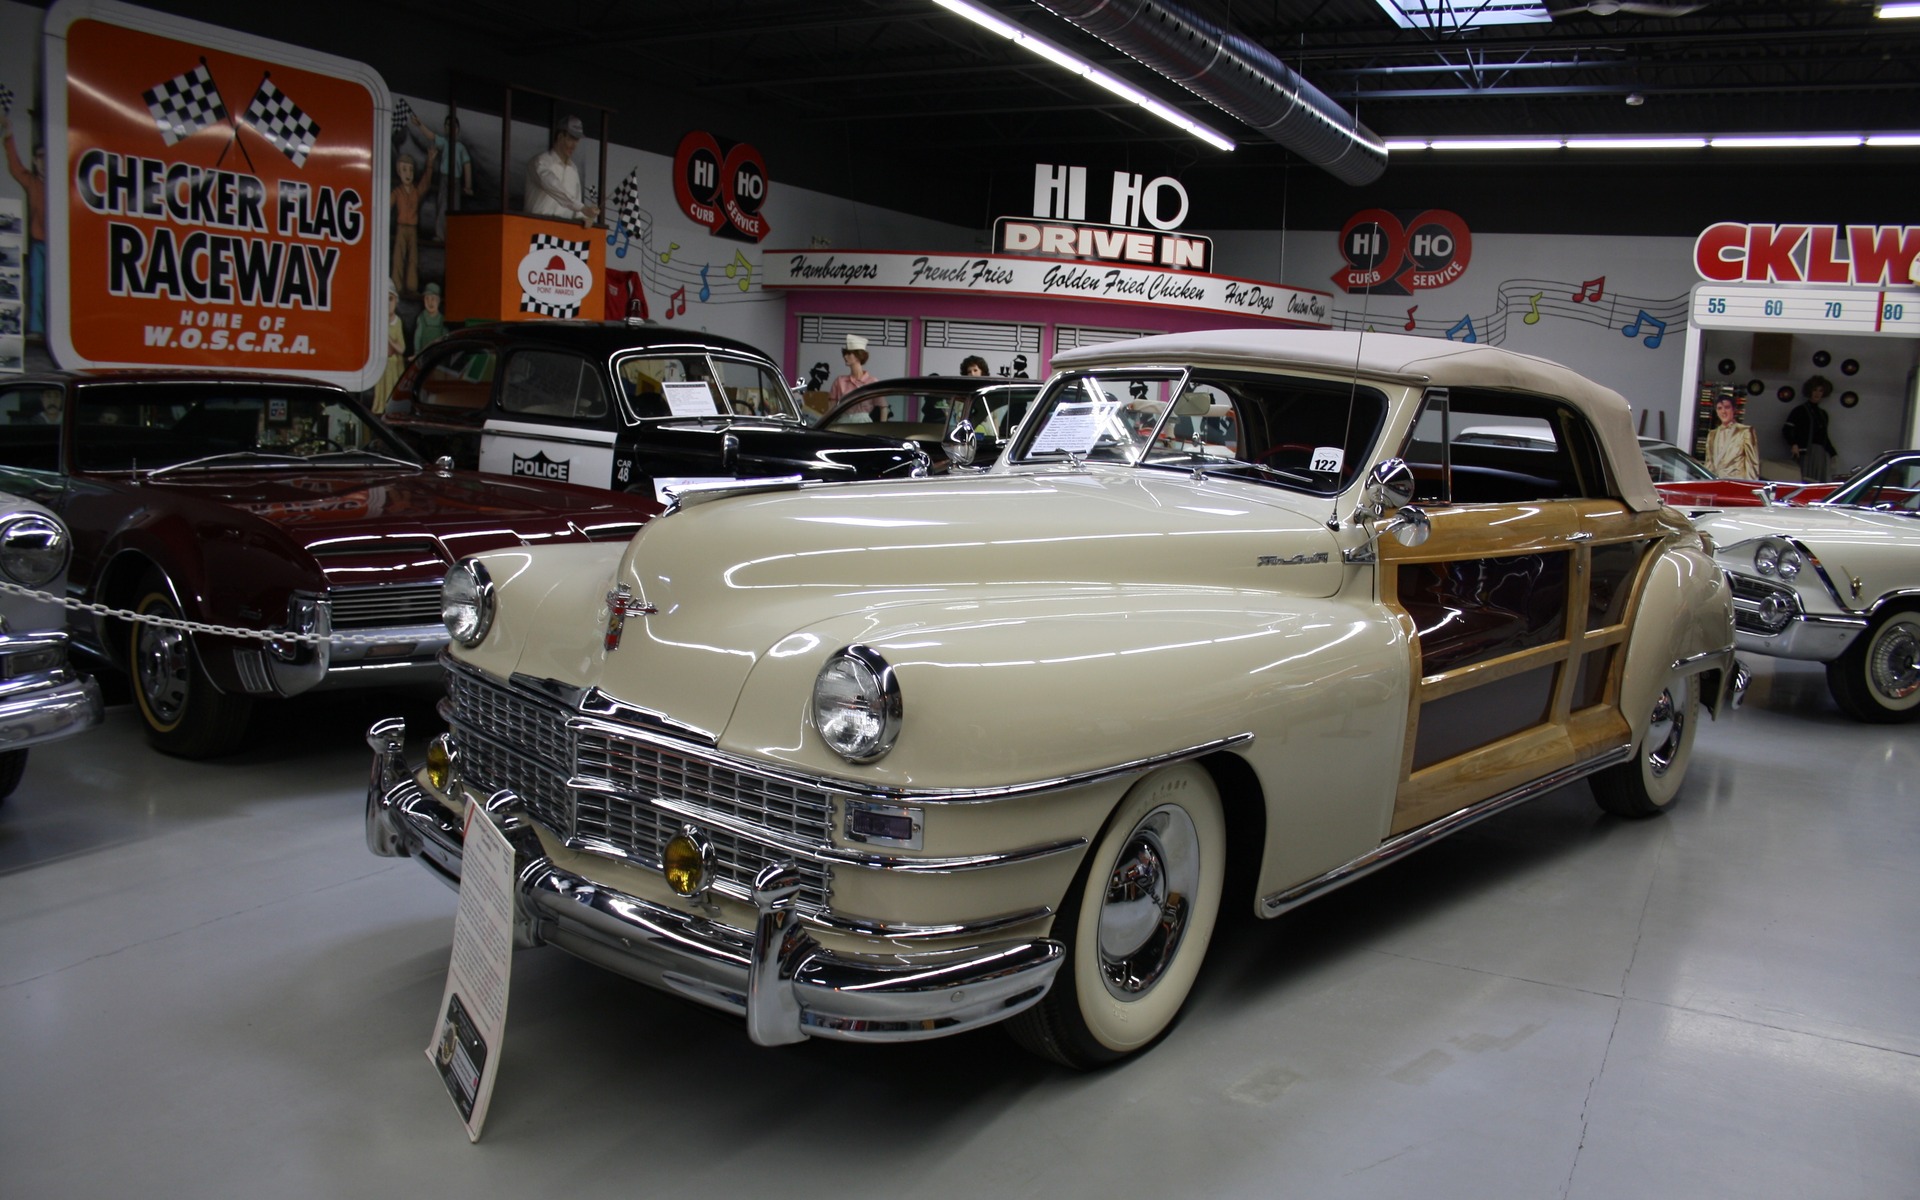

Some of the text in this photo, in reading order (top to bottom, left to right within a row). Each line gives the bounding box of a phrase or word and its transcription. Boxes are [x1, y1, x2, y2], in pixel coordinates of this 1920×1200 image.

[694, 159, 763, 199] HI HO
[77, 149, 364, 245] CHECKER FLAG
[1033, 163, 1189, 231] HI HO
[690, 201, 759, 233] CURB SERVICE
[1004, 221, 1205, 269] DRIVE IN
[1352, 233, 1453, 257] HI HO
[1693, 222, 1920, 287] CKLW
[108, 221, 340, 311] RACEWAY
[528, 270, 583, 289] CARLING
[789, 255, 1013, 287] Hamburgers French Fries
[1348, 261, 1463, 286] CURB SERVICE
[1042, 265, 1205, 300] Golden Fried Chicken
[1224, 282, 1274, 314] Hot Dogs
[180, 310, 286, 331] HOME OF
[1287, 293, 1325, 322] Onion Rings
[1708, 298, 1903, 320] 55 60 70 80
[143, 325, 316, 355] W.O.S.C.R.A.
[514, 459, 632, 479] POLICE CAR
[617, 467, 629, 482] 48
[1314, 459, 1337, 471] 122
